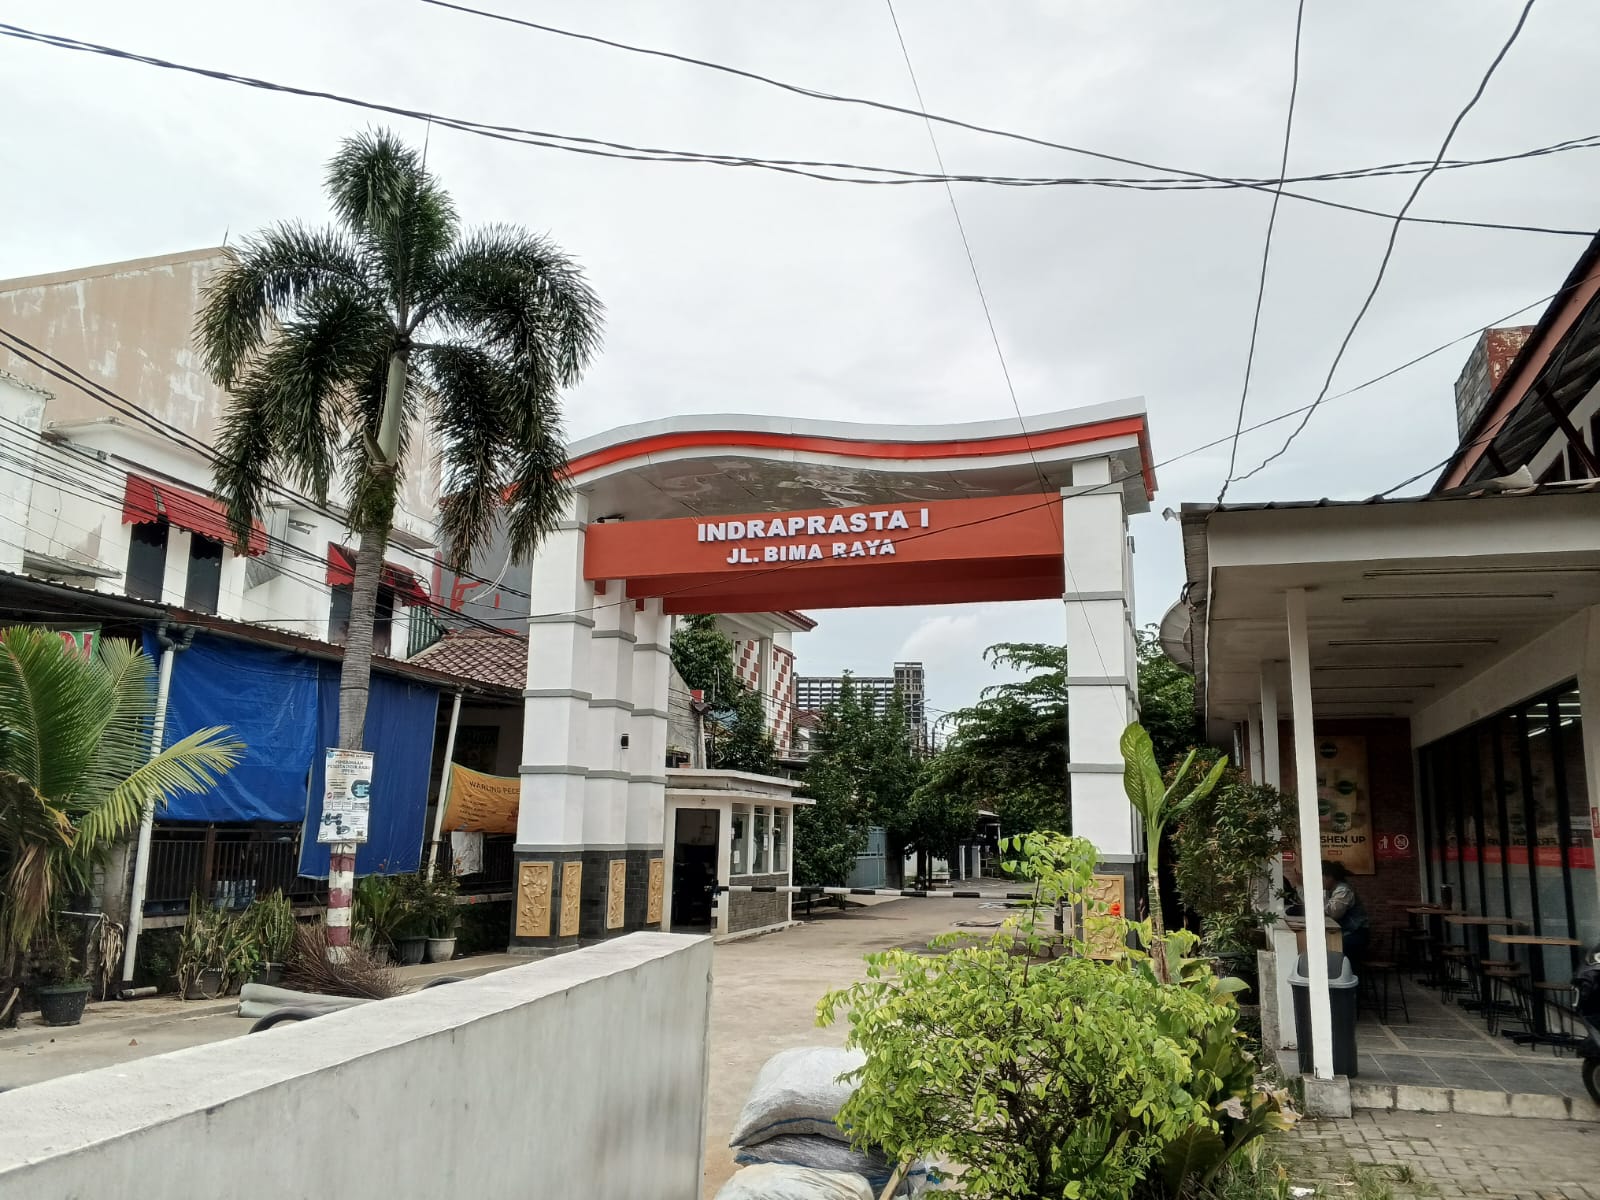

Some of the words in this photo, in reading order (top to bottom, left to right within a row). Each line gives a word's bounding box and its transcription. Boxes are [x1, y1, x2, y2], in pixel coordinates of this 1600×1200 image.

[698, 510, 910, 542] INDRAPRASTA
[920, 508, 929, 528] I
[726, 548, 760, 565] JL.
[764, 544, 824, 562] BIMA
[832, 539, 896, 559] RAYA
[503, 787, 521, 795] PECE
[1320, 835, 1349, 844] SHEN
[1351, 835, 1366, 844] UP
